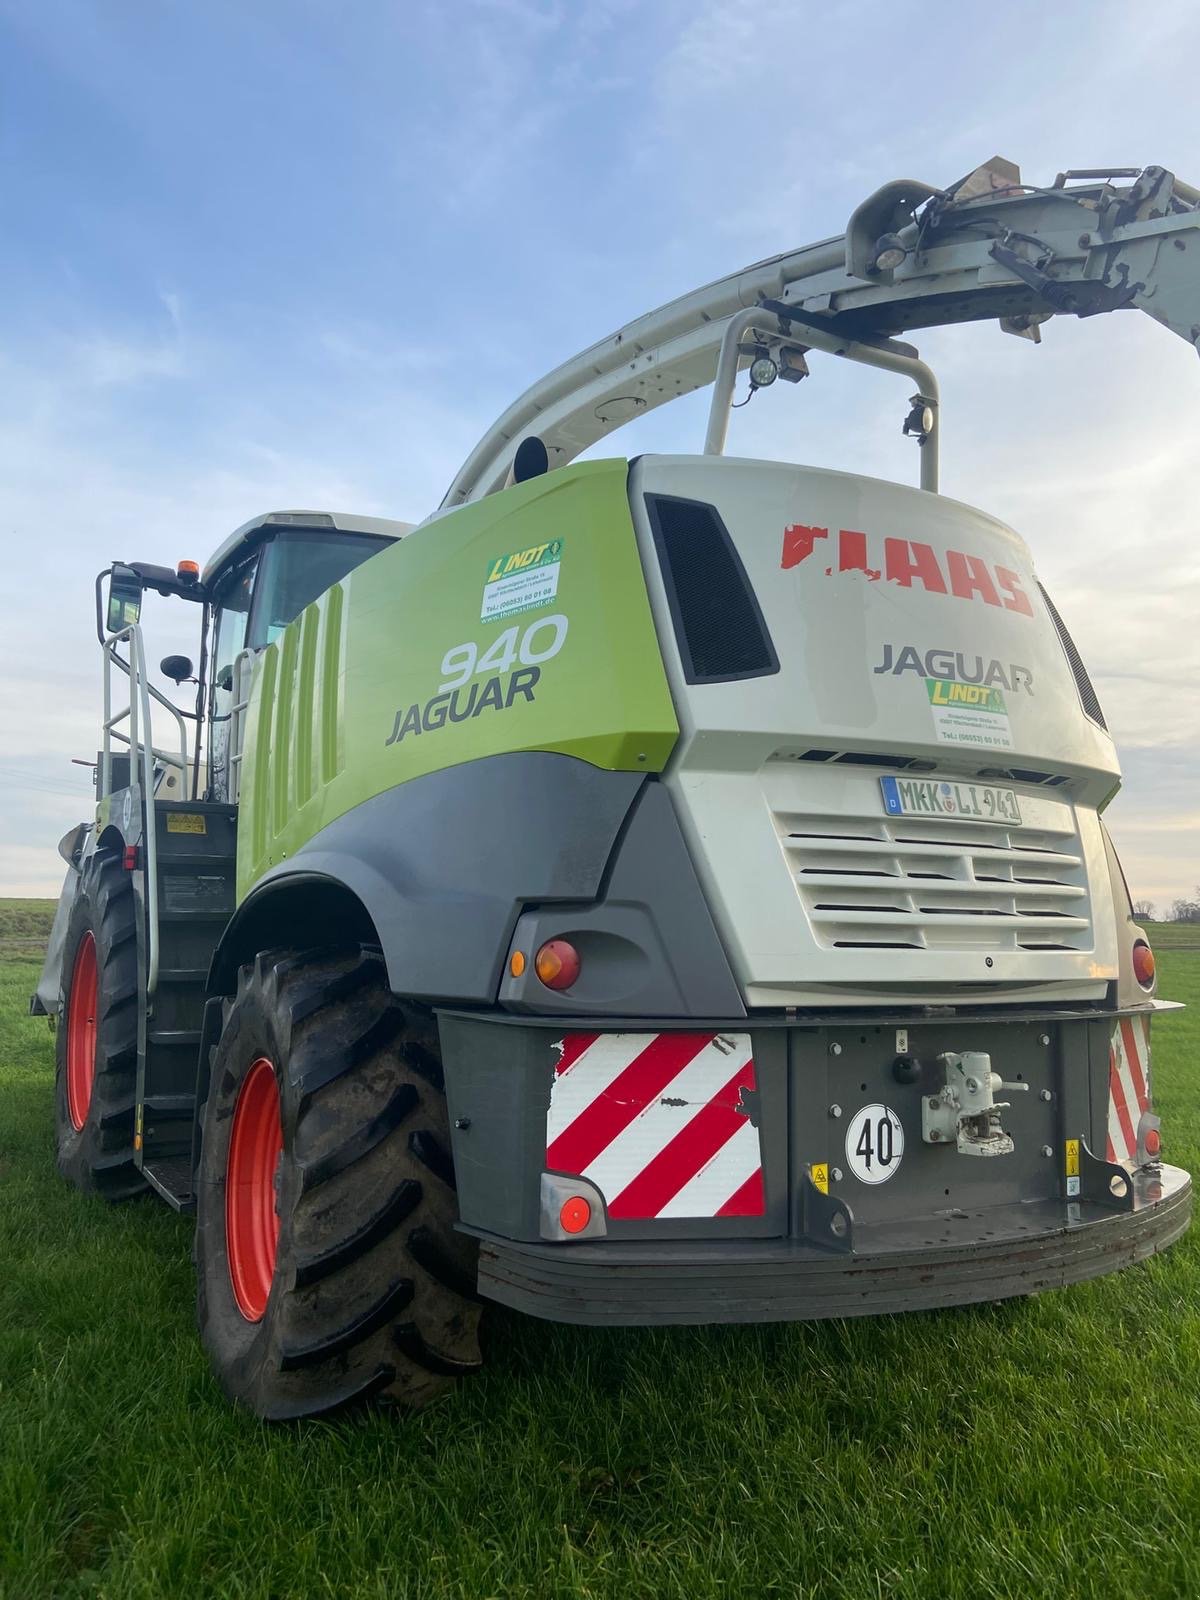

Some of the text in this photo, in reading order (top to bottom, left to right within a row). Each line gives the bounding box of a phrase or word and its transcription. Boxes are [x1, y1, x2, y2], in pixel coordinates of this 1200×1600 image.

[487, 543, 550, 583] LINDT
[438, 614, 569, 694] 940
[873, 644, 1034, 697] JAGUAR
[385, 666, 541, 746] JAGUAR
[931, 681, 990, 705] LINDT
[898, 781, 944, 812] MKK
[954, 785, 982, 815] LI
[984, 789, 1021, 819] 941
[856, 1118, 893, 1167] 40
